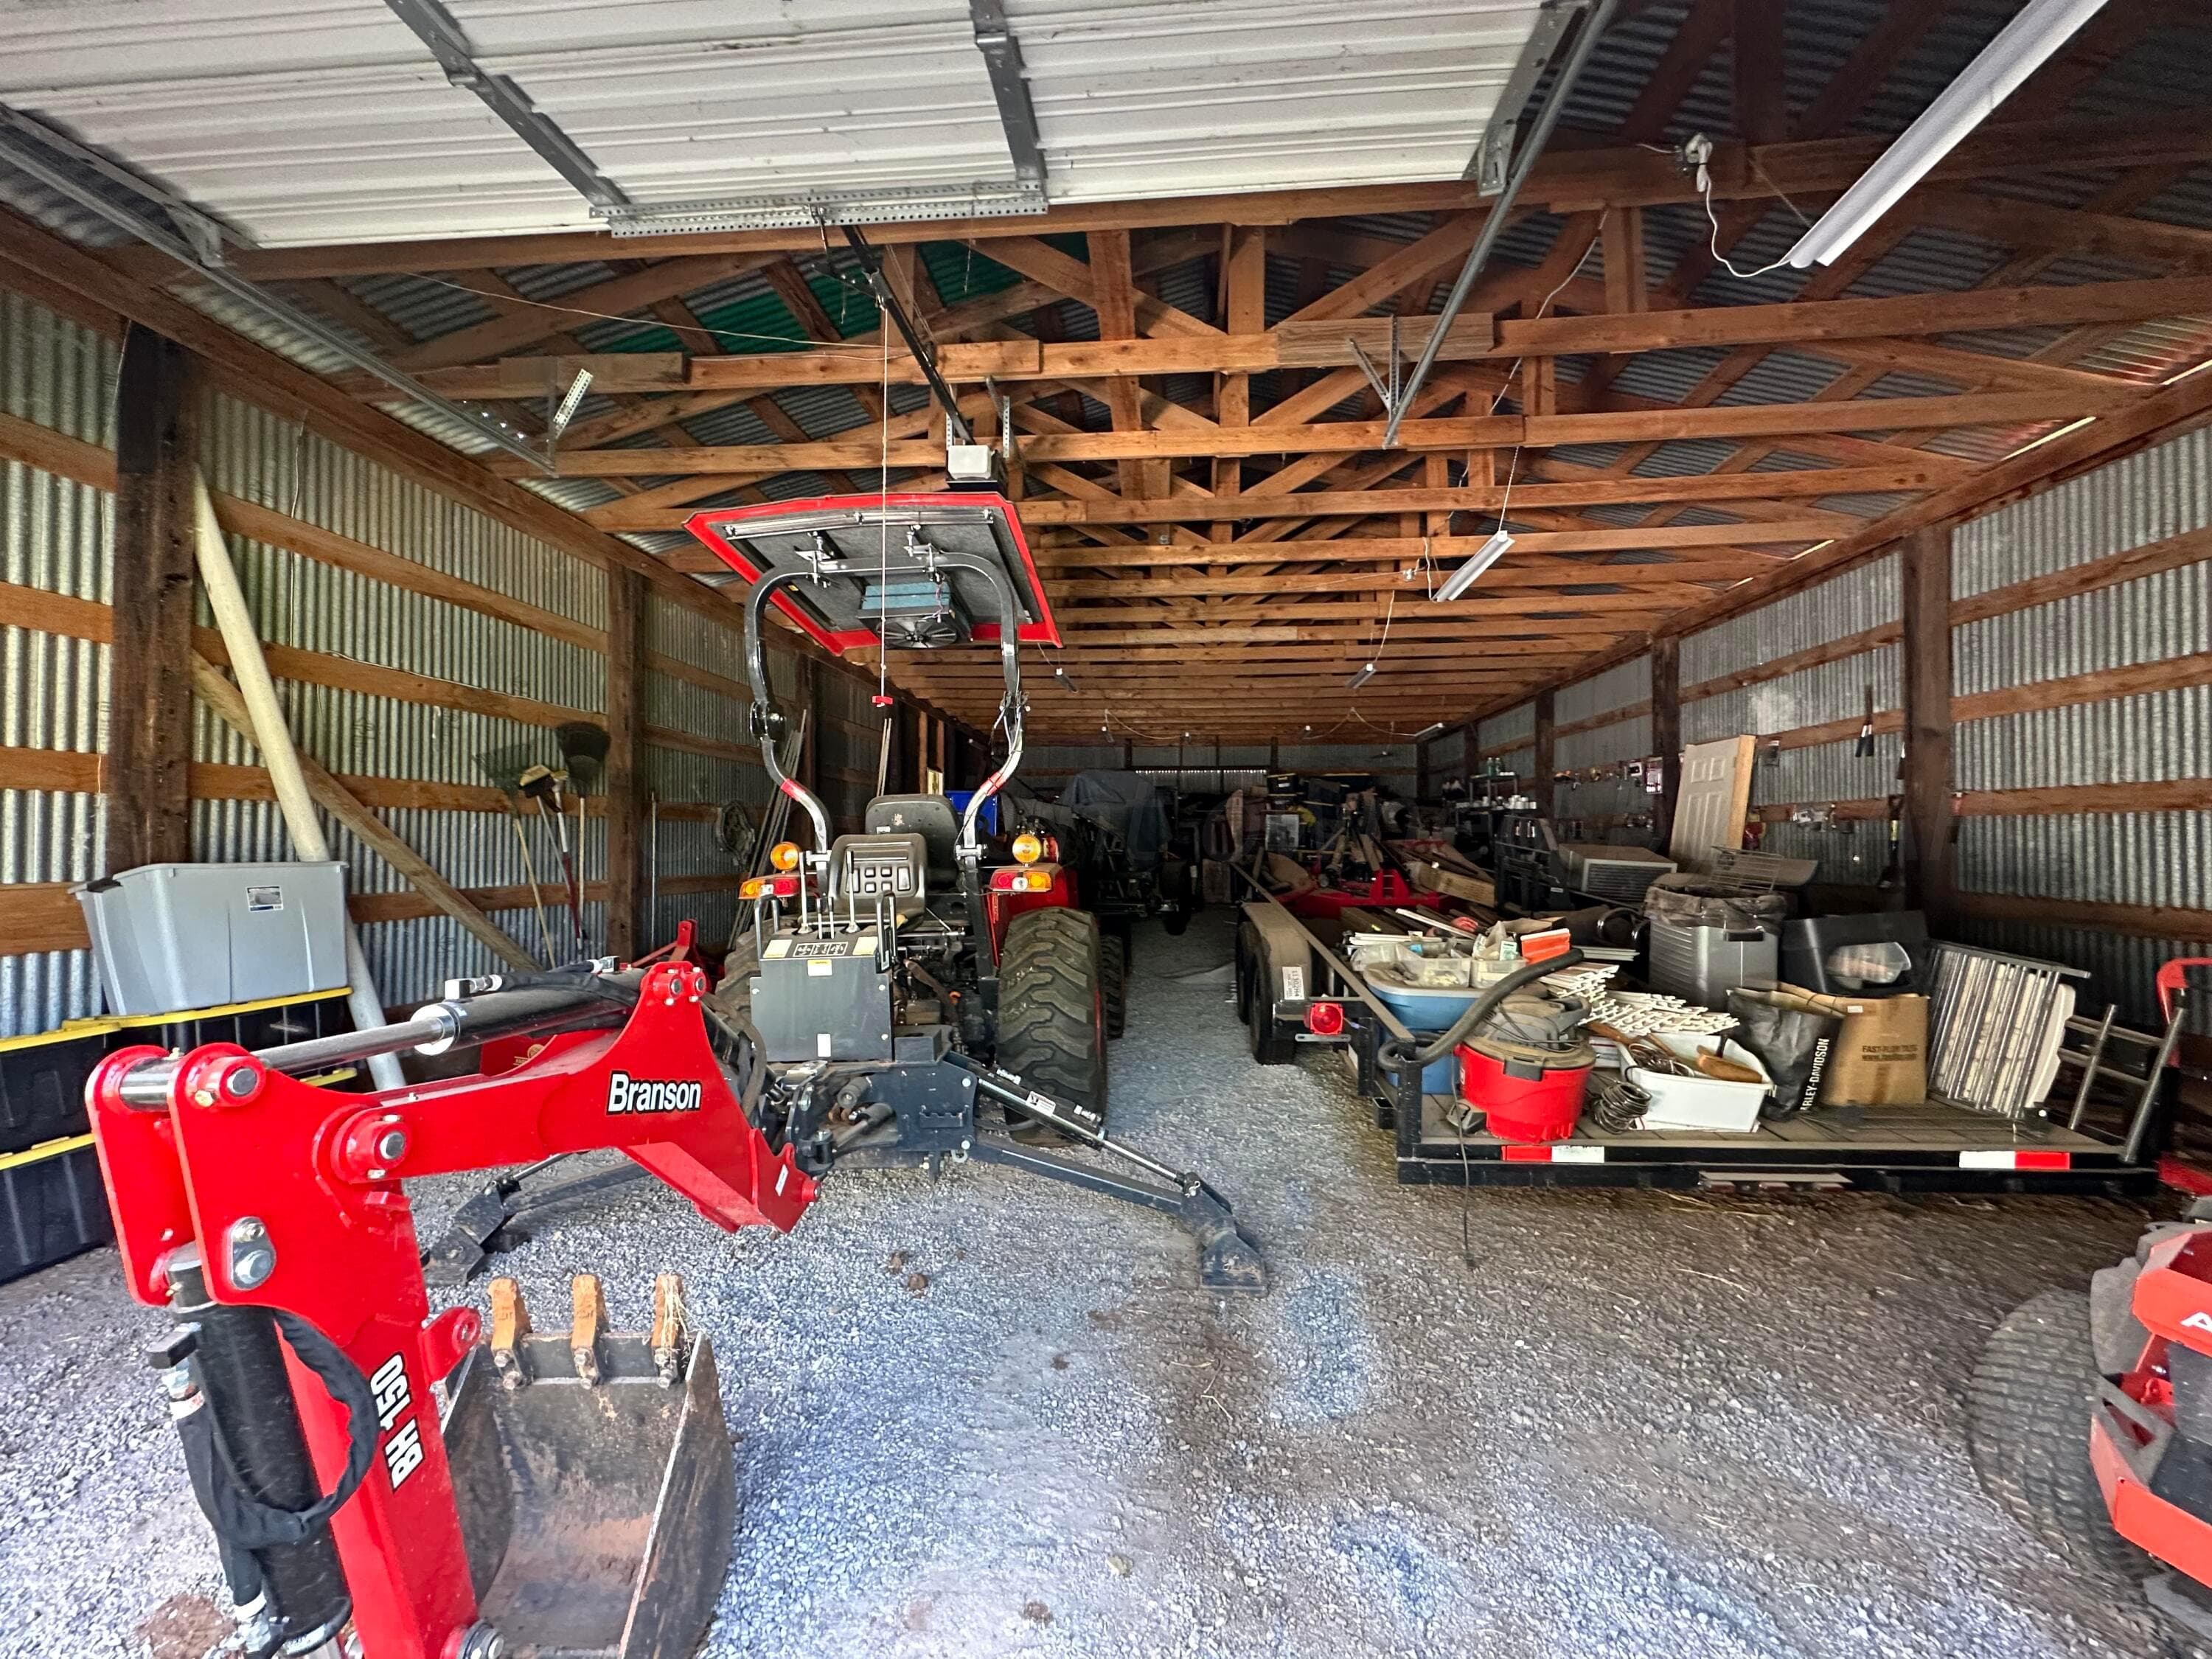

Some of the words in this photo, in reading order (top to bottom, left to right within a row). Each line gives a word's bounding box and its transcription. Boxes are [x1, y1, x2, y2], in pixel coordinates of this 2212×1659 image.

[608, 1074, 701, 1113] Branson
[370, 1354, 411, 1430] 150
[385, 1419, 423, 1489] BH
